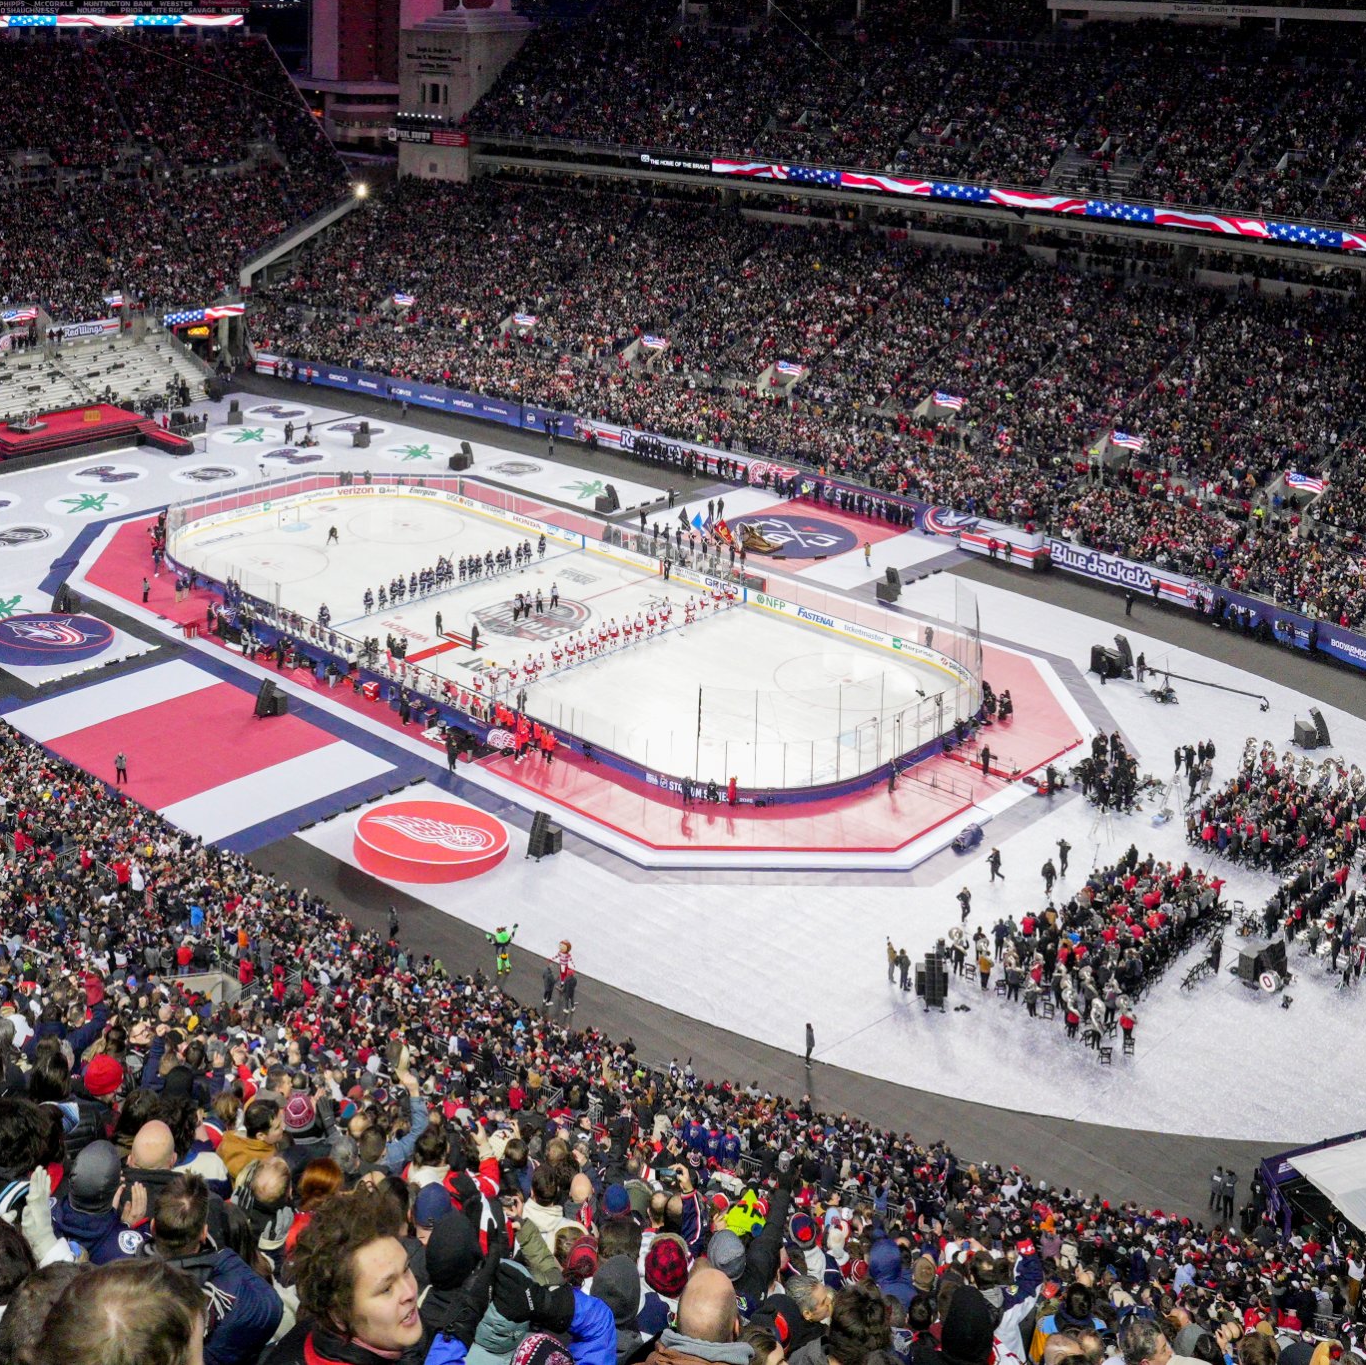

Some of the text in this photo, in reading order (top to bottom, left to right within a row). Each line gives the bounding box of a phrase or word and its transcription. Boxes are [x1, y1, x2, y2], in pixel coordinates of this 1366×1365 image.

[83, 0, 154, 8] HUNTINGTON BANK
[159, 0, 193, 8] WEBSTER
[188, 6, 217, 14] SAVAGE
[221, 6, 250, 14] NETJETS
[64, 324, 103, 338] Red Wings
[452, 399, 474, 409] verizon
[337, 486, 375, 496] verizon
[408, 487, 438, 497] Energizer
[446, 493, 474, 508] DISCOVER
[512, 514, 541, 530] HONDA
[1050, 540, 1153, 590] Blue Jackets
[765, 595, 786, 611] NFP
[797, 606, 835, 628] FASTENAL
[381, 620, 430, 643] verizon
[844, 623, 885, 643] ticketmaster
